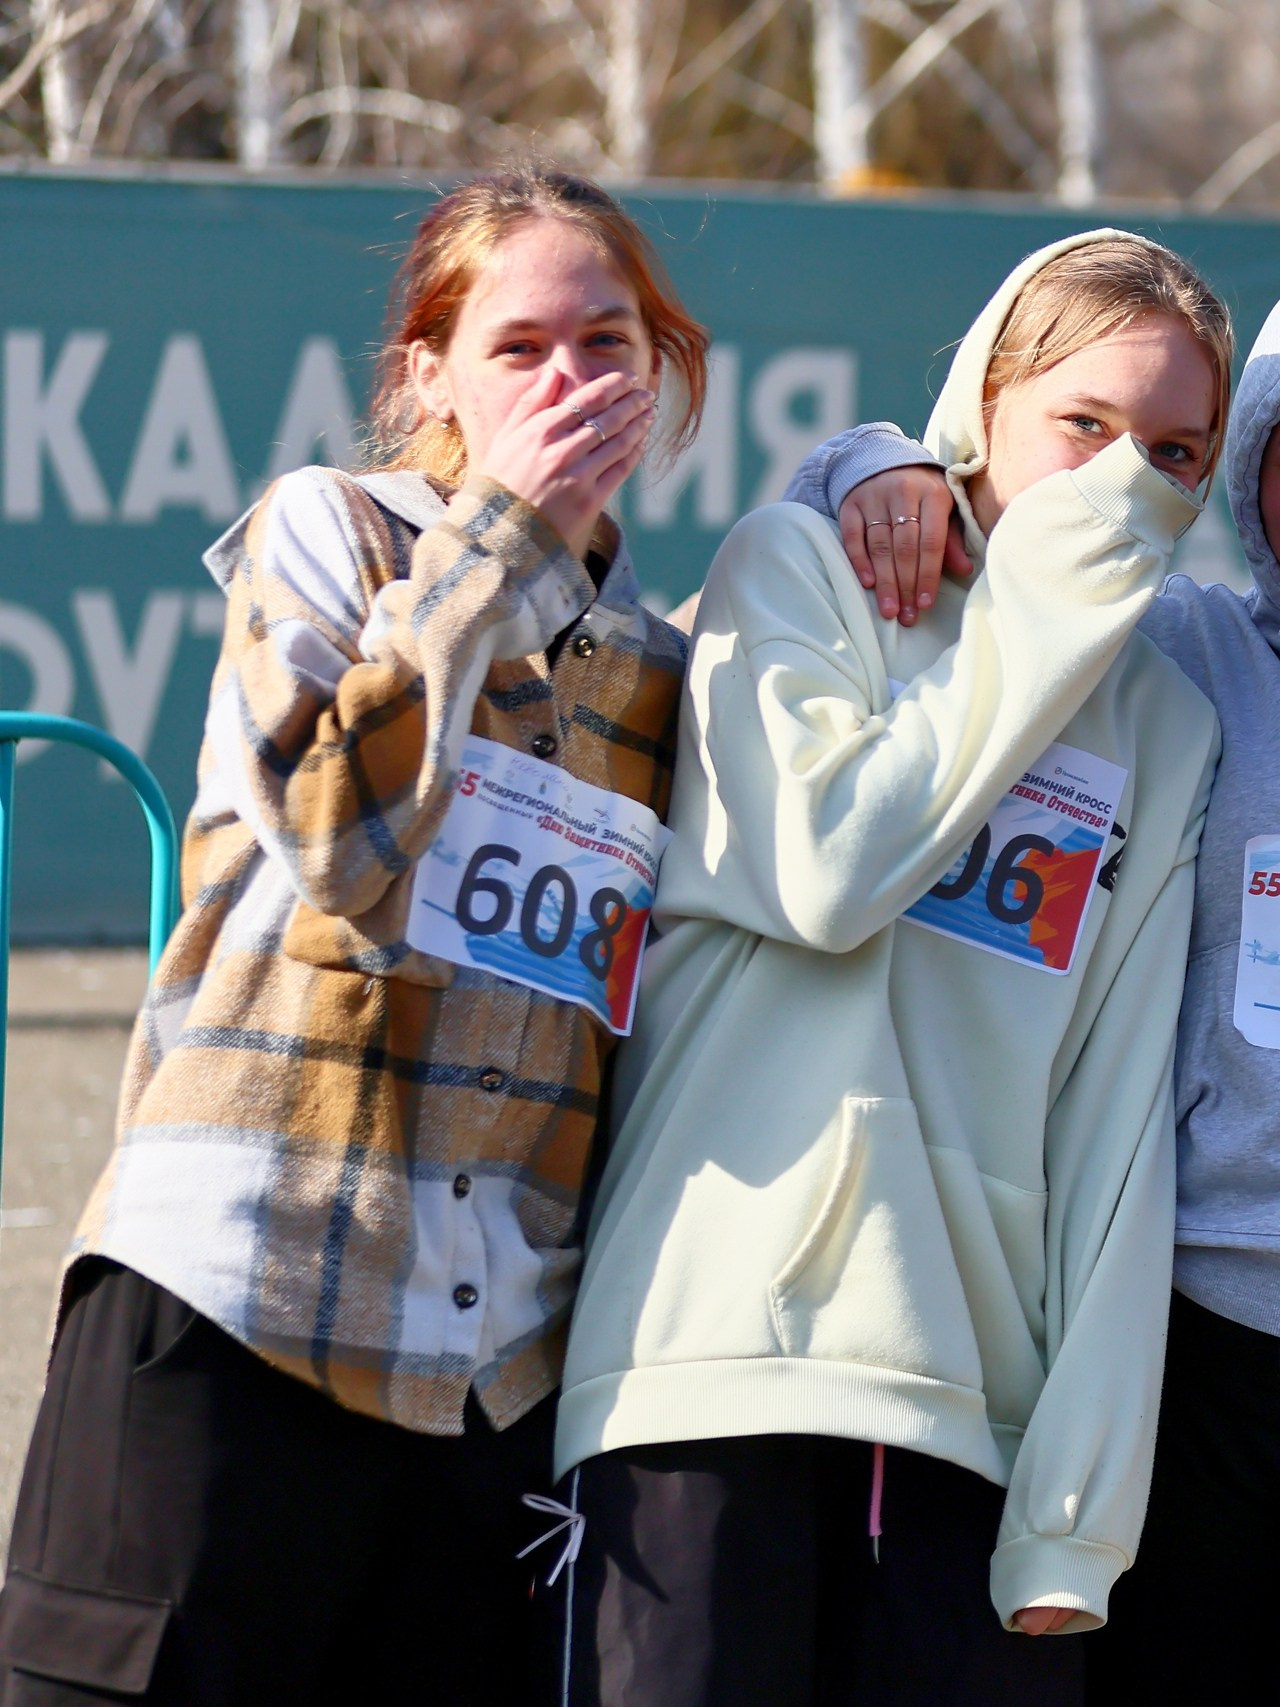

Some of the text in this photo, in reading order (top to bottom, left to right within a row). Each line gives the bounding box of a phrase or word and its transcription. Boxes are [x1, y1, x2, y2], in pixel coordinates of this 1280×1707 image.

[482, 779, 597, 836] МЕЖРЕГИОНАЛЬНЫЙ
[602, 827, 645, 859] ЗИМНИЙ
[1020, 772, 1112, 815] ЗИМНИЙ КРОСС
[1047, 793, 1109, 828] Отечества»
[456, 843, 629, 982] 608
[927, 822, 1056, 925] 06
